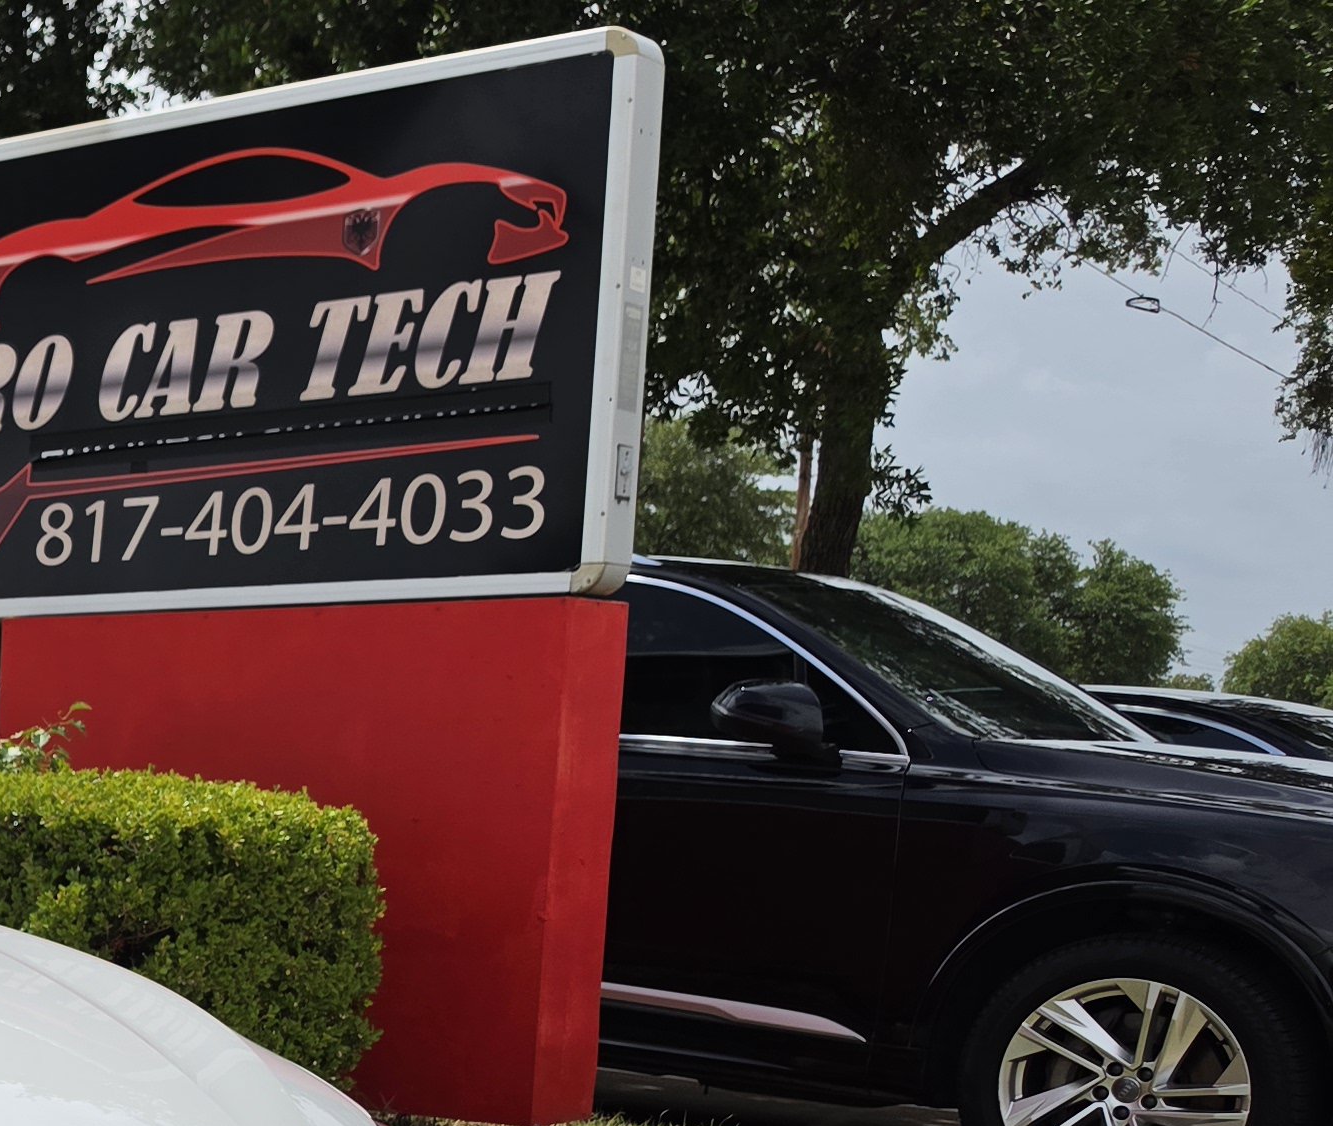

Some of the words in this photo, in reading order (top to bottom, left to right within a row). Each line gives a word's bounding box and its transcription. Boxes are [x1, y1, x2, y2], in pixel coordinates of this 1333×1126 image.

[97, 310, 275, 421] CAR
[298, 270, 561, 401] TECH
[35, 465, 546, 566] 817-404-4033
